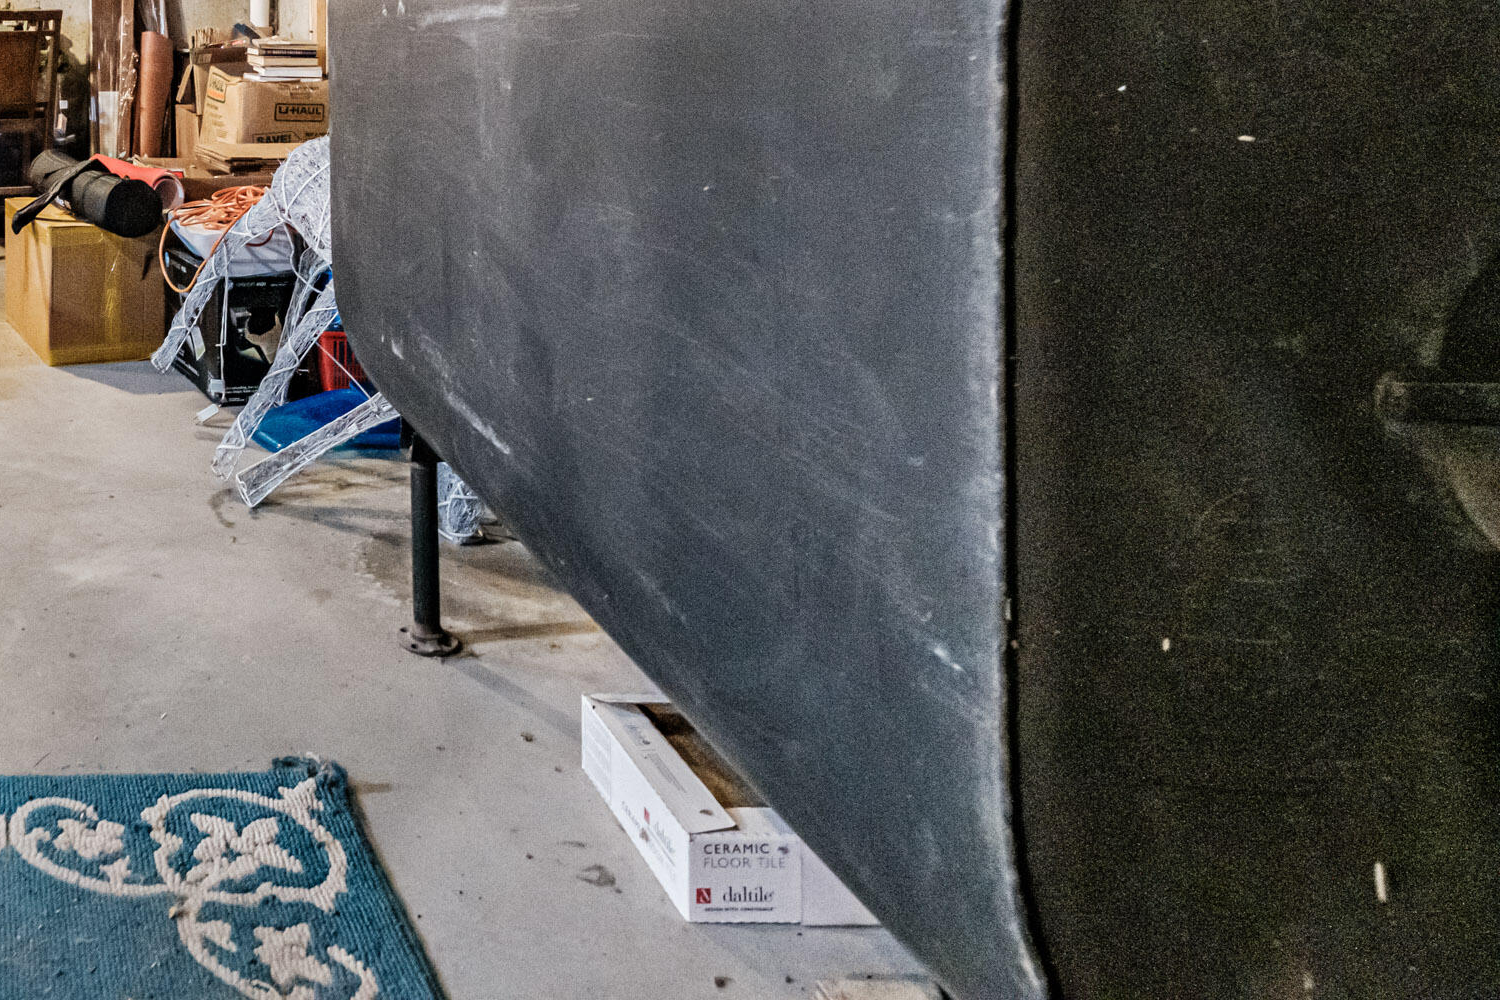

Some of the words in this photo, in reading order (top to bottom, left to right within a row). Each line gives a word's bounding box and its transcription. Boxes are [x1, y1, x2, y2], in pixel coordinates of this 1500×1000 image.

[278, 106, 321, 115] U-HAUL
[703, 843, 770, 855] CERAMIC
[703, 857, 751, 868] FLOOR
[758, 857, 786, 868] TILE
[723, 886, 774, 902] daltile
